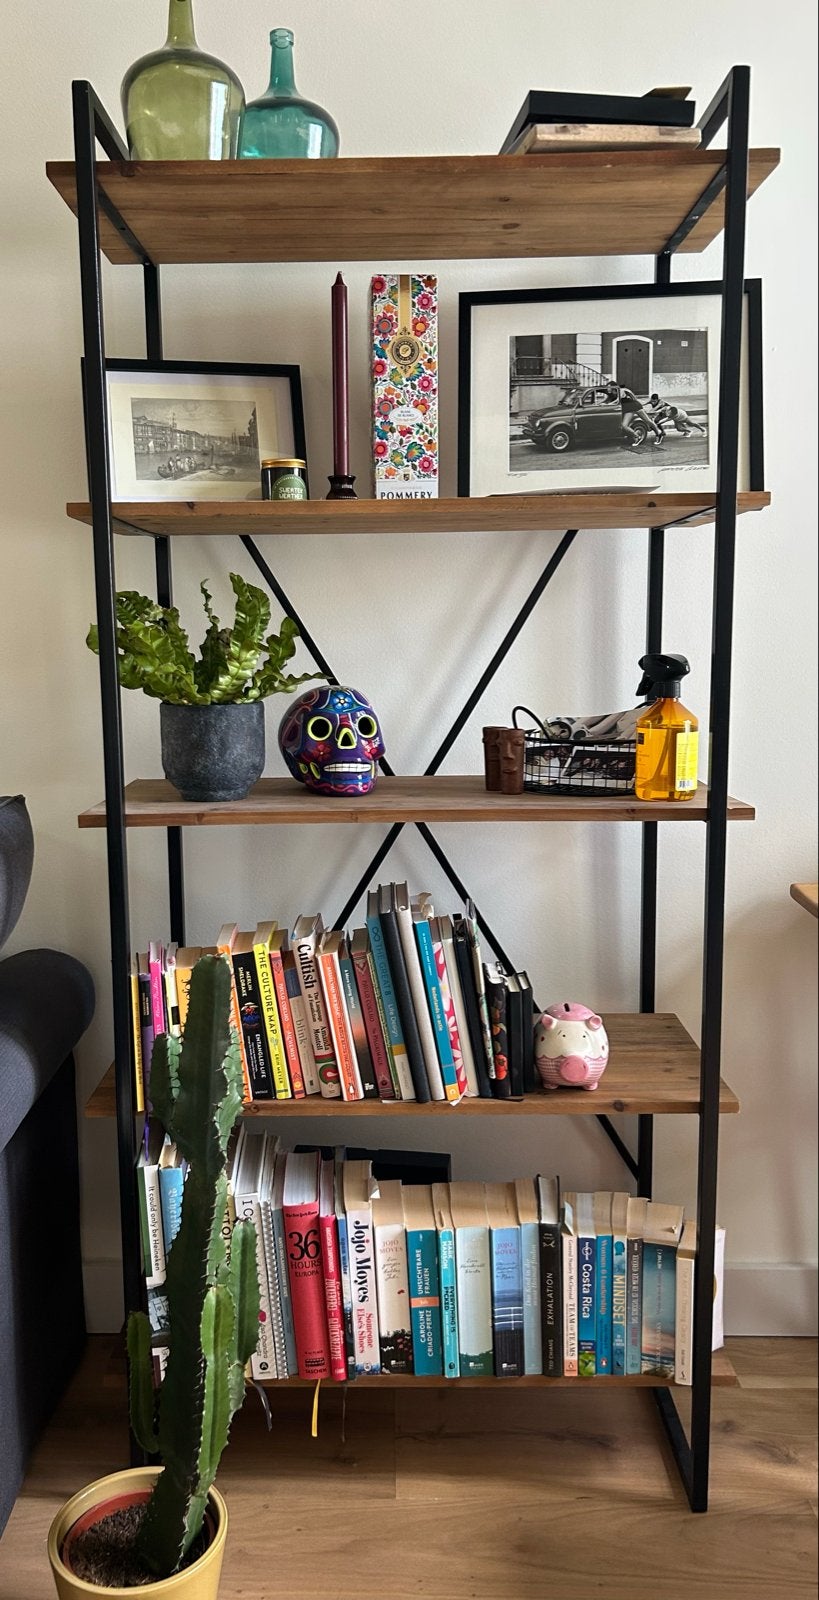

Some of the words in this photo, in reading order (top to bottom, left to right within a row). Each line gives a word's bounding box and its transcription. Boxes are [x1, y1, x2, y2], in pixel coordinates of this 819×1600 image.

[258, 951, 267, 969] THE
[297, 944, 317, 989] Cultish
[376, 944, 384, 962] THE
[238, 967, 247, 997] SHELDRAKE
[378, 963, 390, 989] GREAT
[260, 972, 273, 1013] CULTURE
[431, 986, 440, 1014] Nederlands
[267, 1015, 278, 1035] MAP
[281, 1001, 289, 1022] COELHO
[314, 1001, 324, 1022] Language
[312, 1028, 324, 1051] Montell
[320, 1025, 330, 1051] Amanda
[390, 1017, 399, 1037] Design
[256, 1034, 265, 1066] ENTANGLED
[149, 1193, 158, 1212] could
[150, 1214, 159, 1227] only
[152, 1229, 160, 1237] be
[288, 1229, 321, 1261] 36
[351, 1220, 370, 1253] Jojo
[152, 1239, 161, 1271] Heineken
[290, 1259, 322, 1270] HOURS
[294, 1268, 321, 1278] EUROPA
[354, 1257, 372, 1303] Moyes
[582, 1264, 592, 1293] Costa
[325, 1278, 338, 1311] ZUCKERFREI
[546, 1272, 554, 1325] EXHALATION
[582, 1297, 592, 1318] Rica
[613, 1274, 625, 1327] MINDSET
[329, 1318, 342, 1360] GLÜCKSREZEPTE
[359, 1330, 367, 1354] Shoes
[366, 1312, 374, 1348] Someone
[426, 1310, 434, 1357] CRIADO-PEREZ
